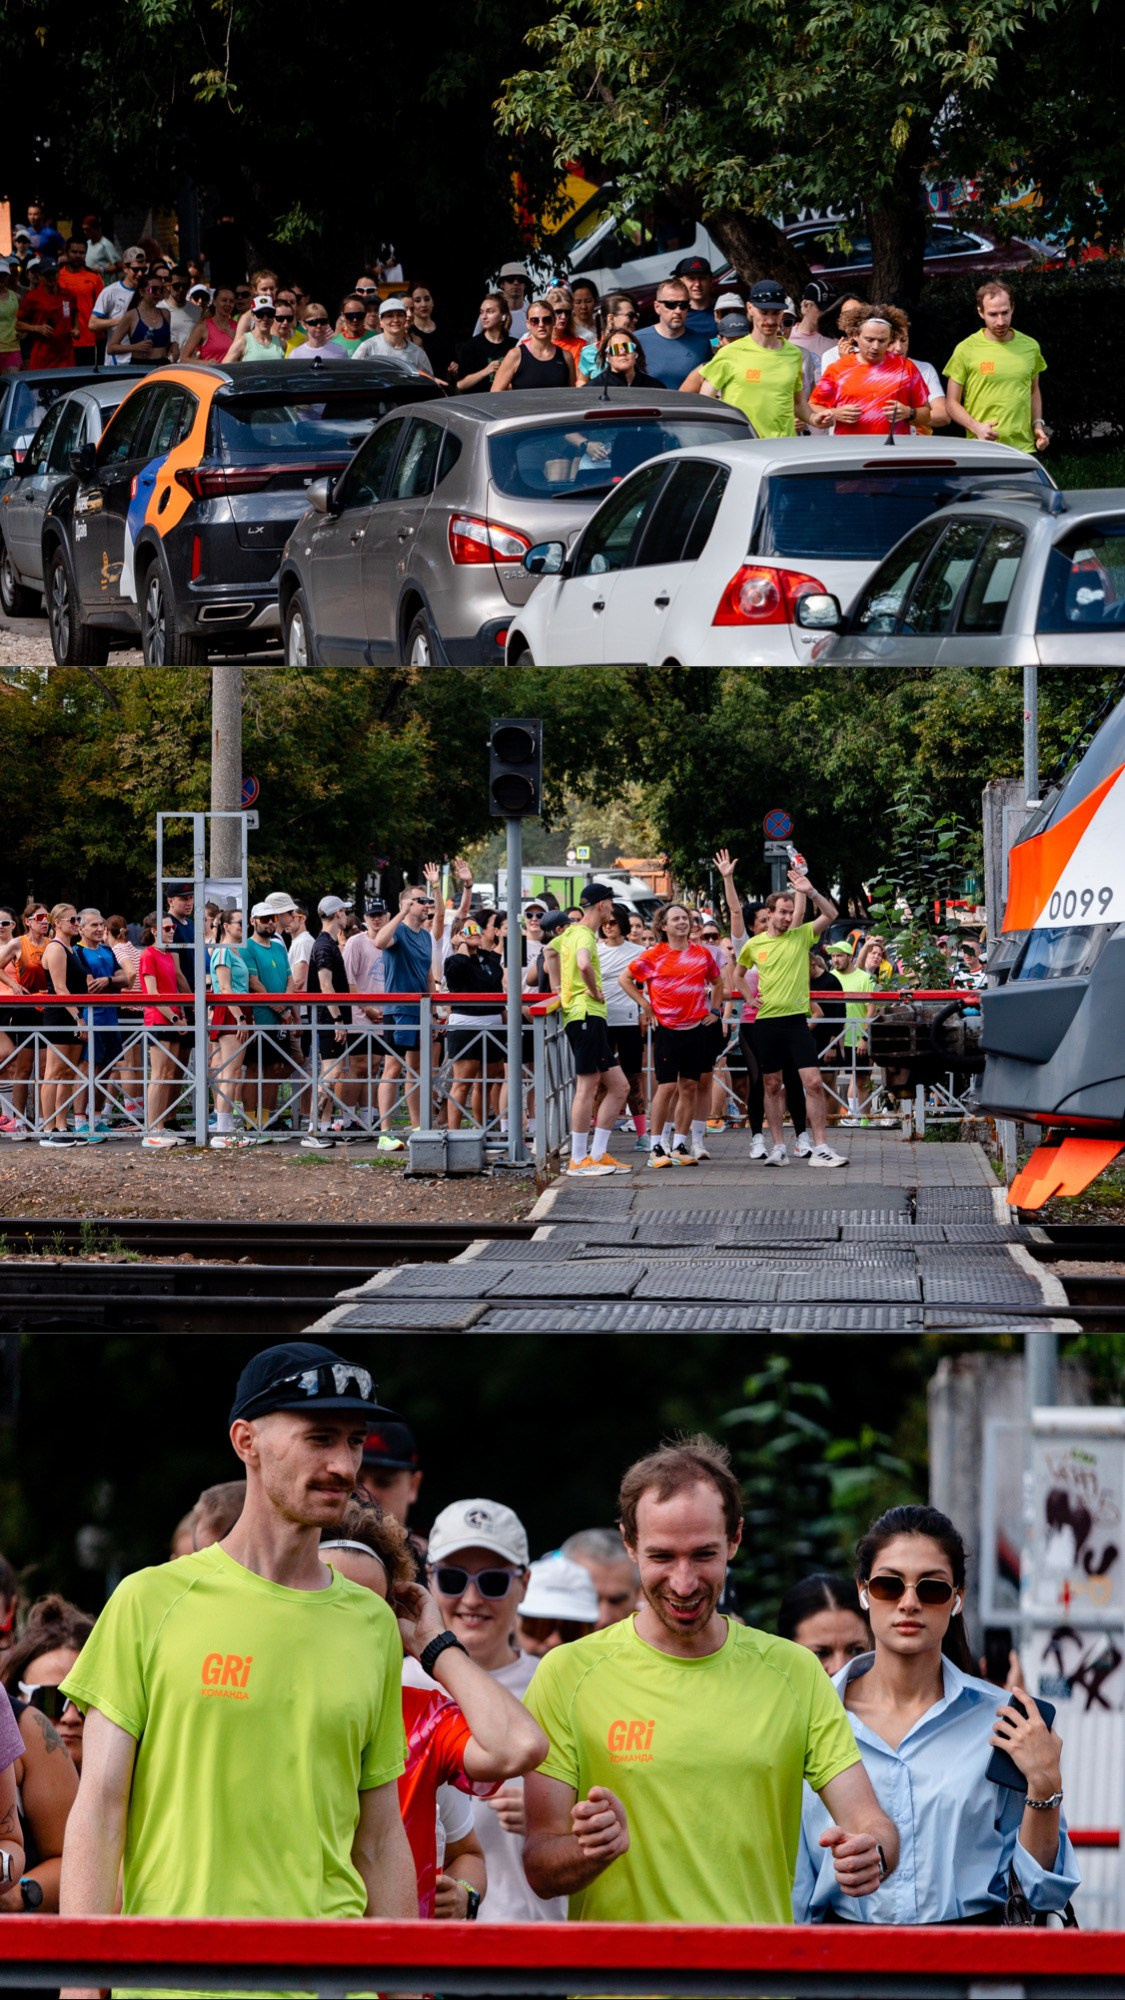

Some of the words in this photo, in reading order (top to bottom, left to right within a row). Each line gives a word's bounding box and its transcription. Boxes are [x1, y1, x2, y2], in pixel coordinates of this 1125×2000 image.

[247, 526, 265, 535] LX
[1049, 886, 1114, 920] 0099
[201, 1652, 253, 1687] GRi
[201, 1688, 249, 1701] КОМАНДА
[608, 1719, 655, 1752] GRi
[609, 1753, 654, 1763] КОМАНДА
